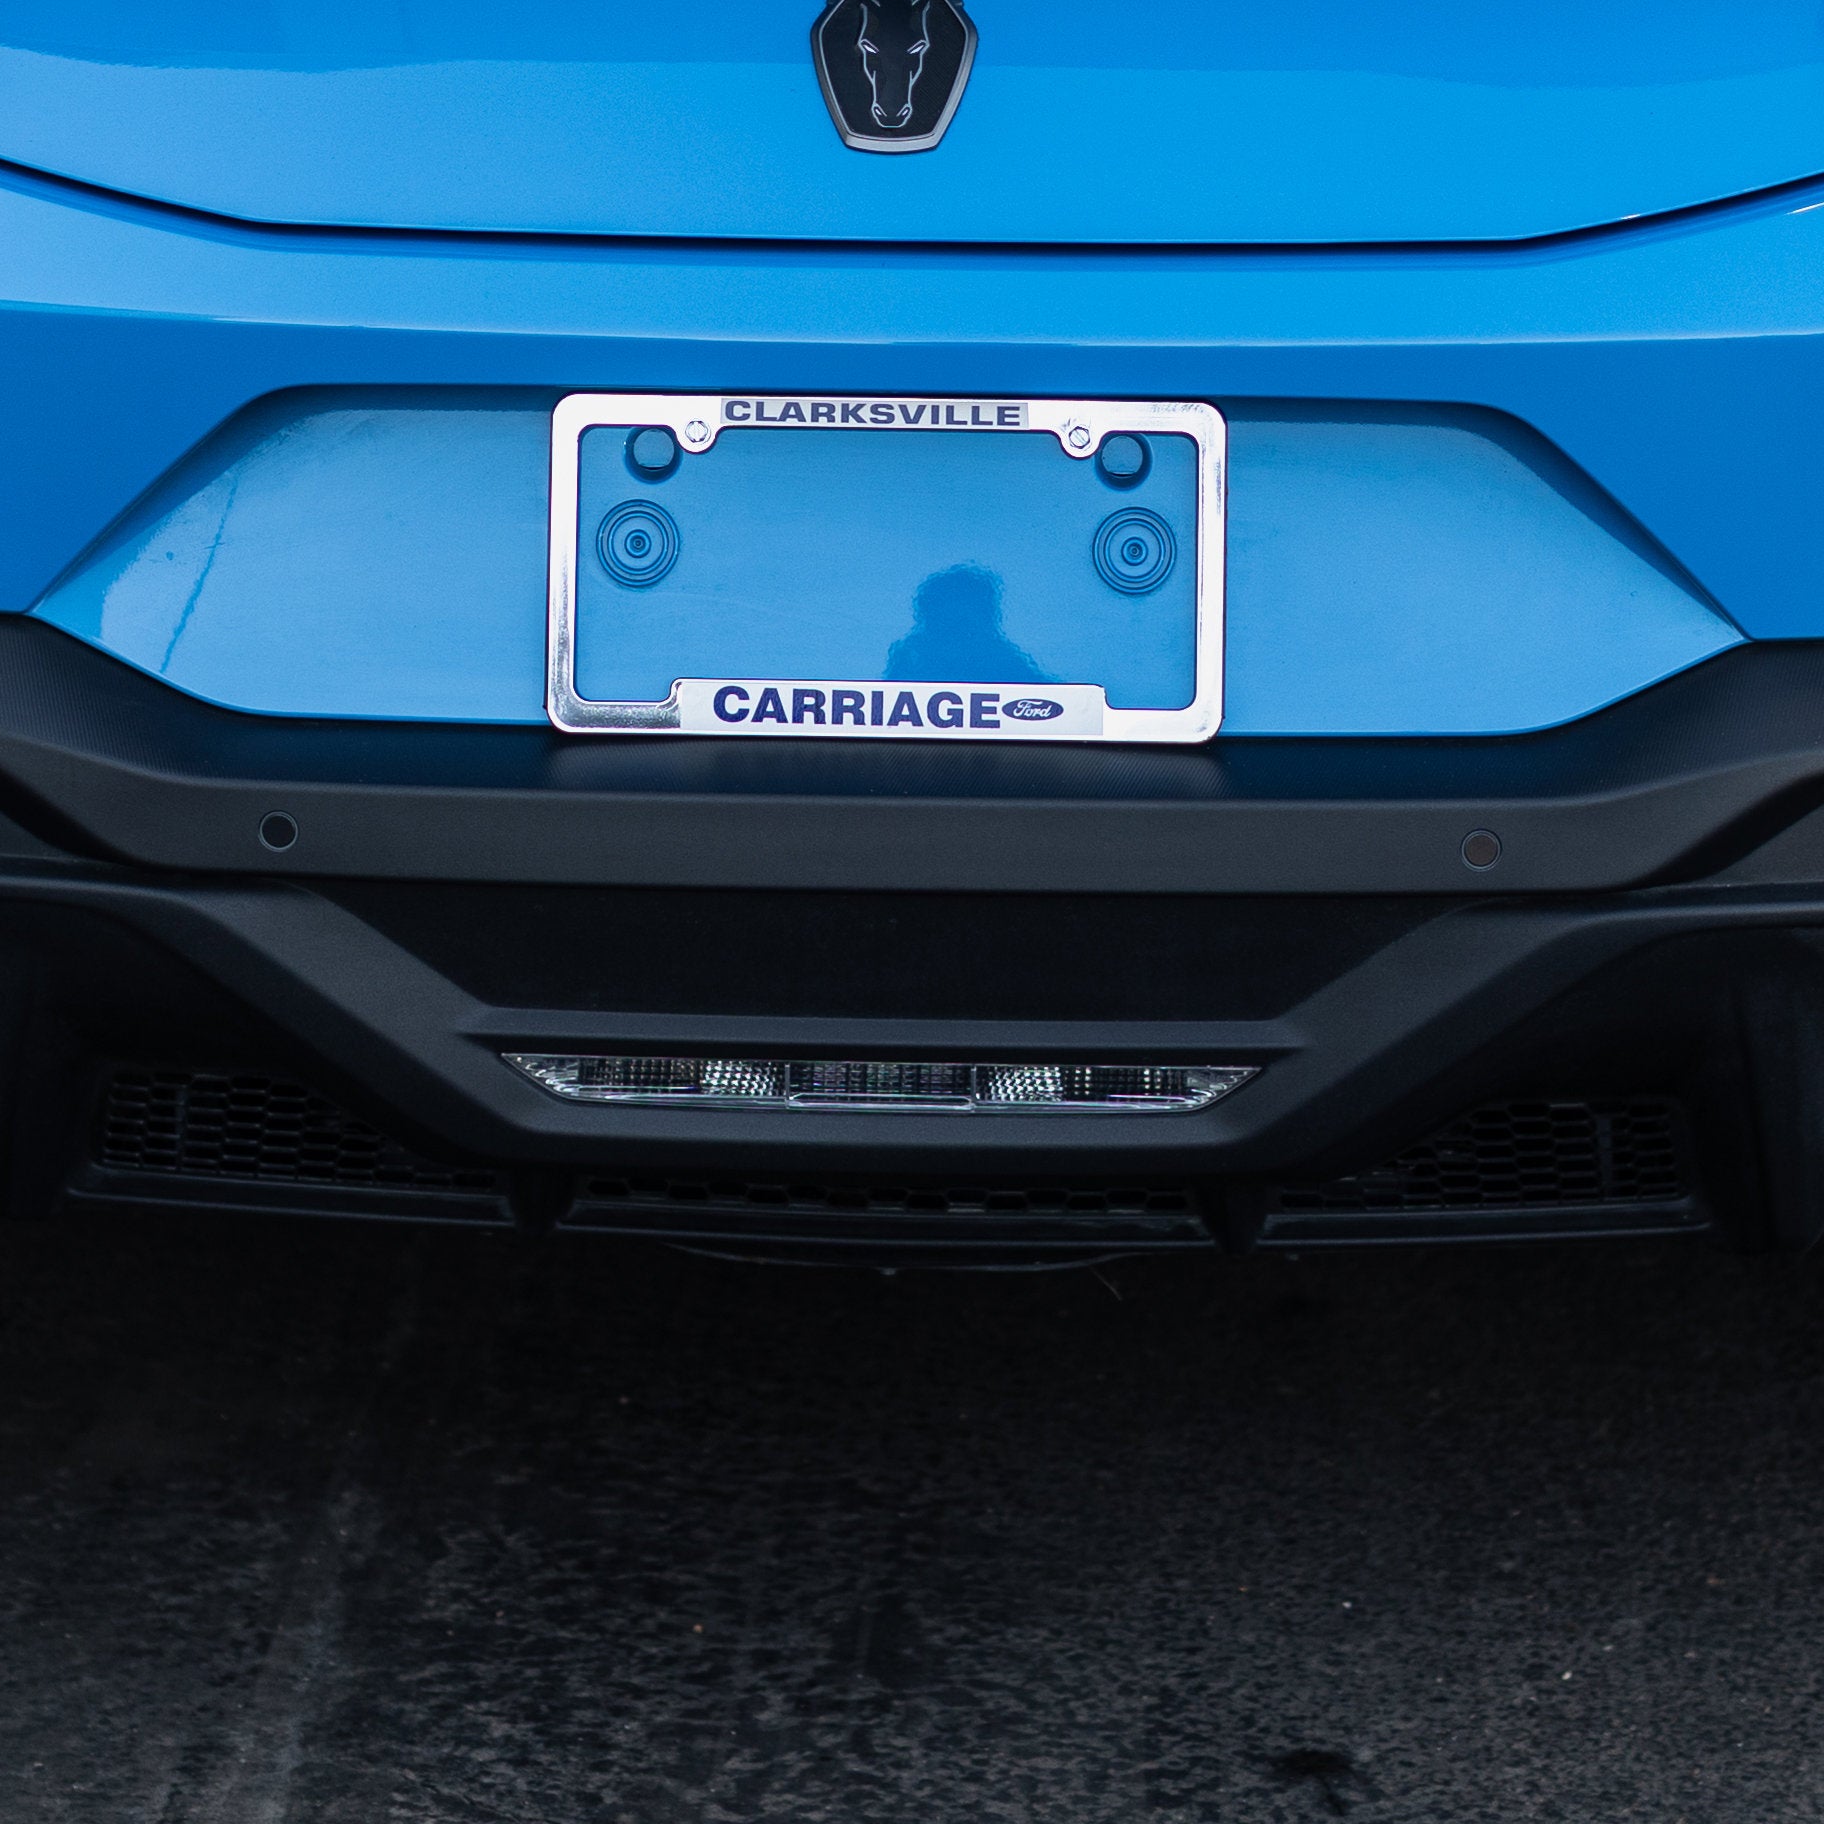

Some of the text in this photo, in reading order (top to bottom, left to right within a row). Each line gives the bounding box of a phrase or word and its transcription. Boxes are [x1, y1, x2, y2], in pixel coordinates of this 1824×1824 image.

[725, 400, 1022, 426] CLARKSVILLE
[713, 685, 1054, 729] CARRIAGE Ford
